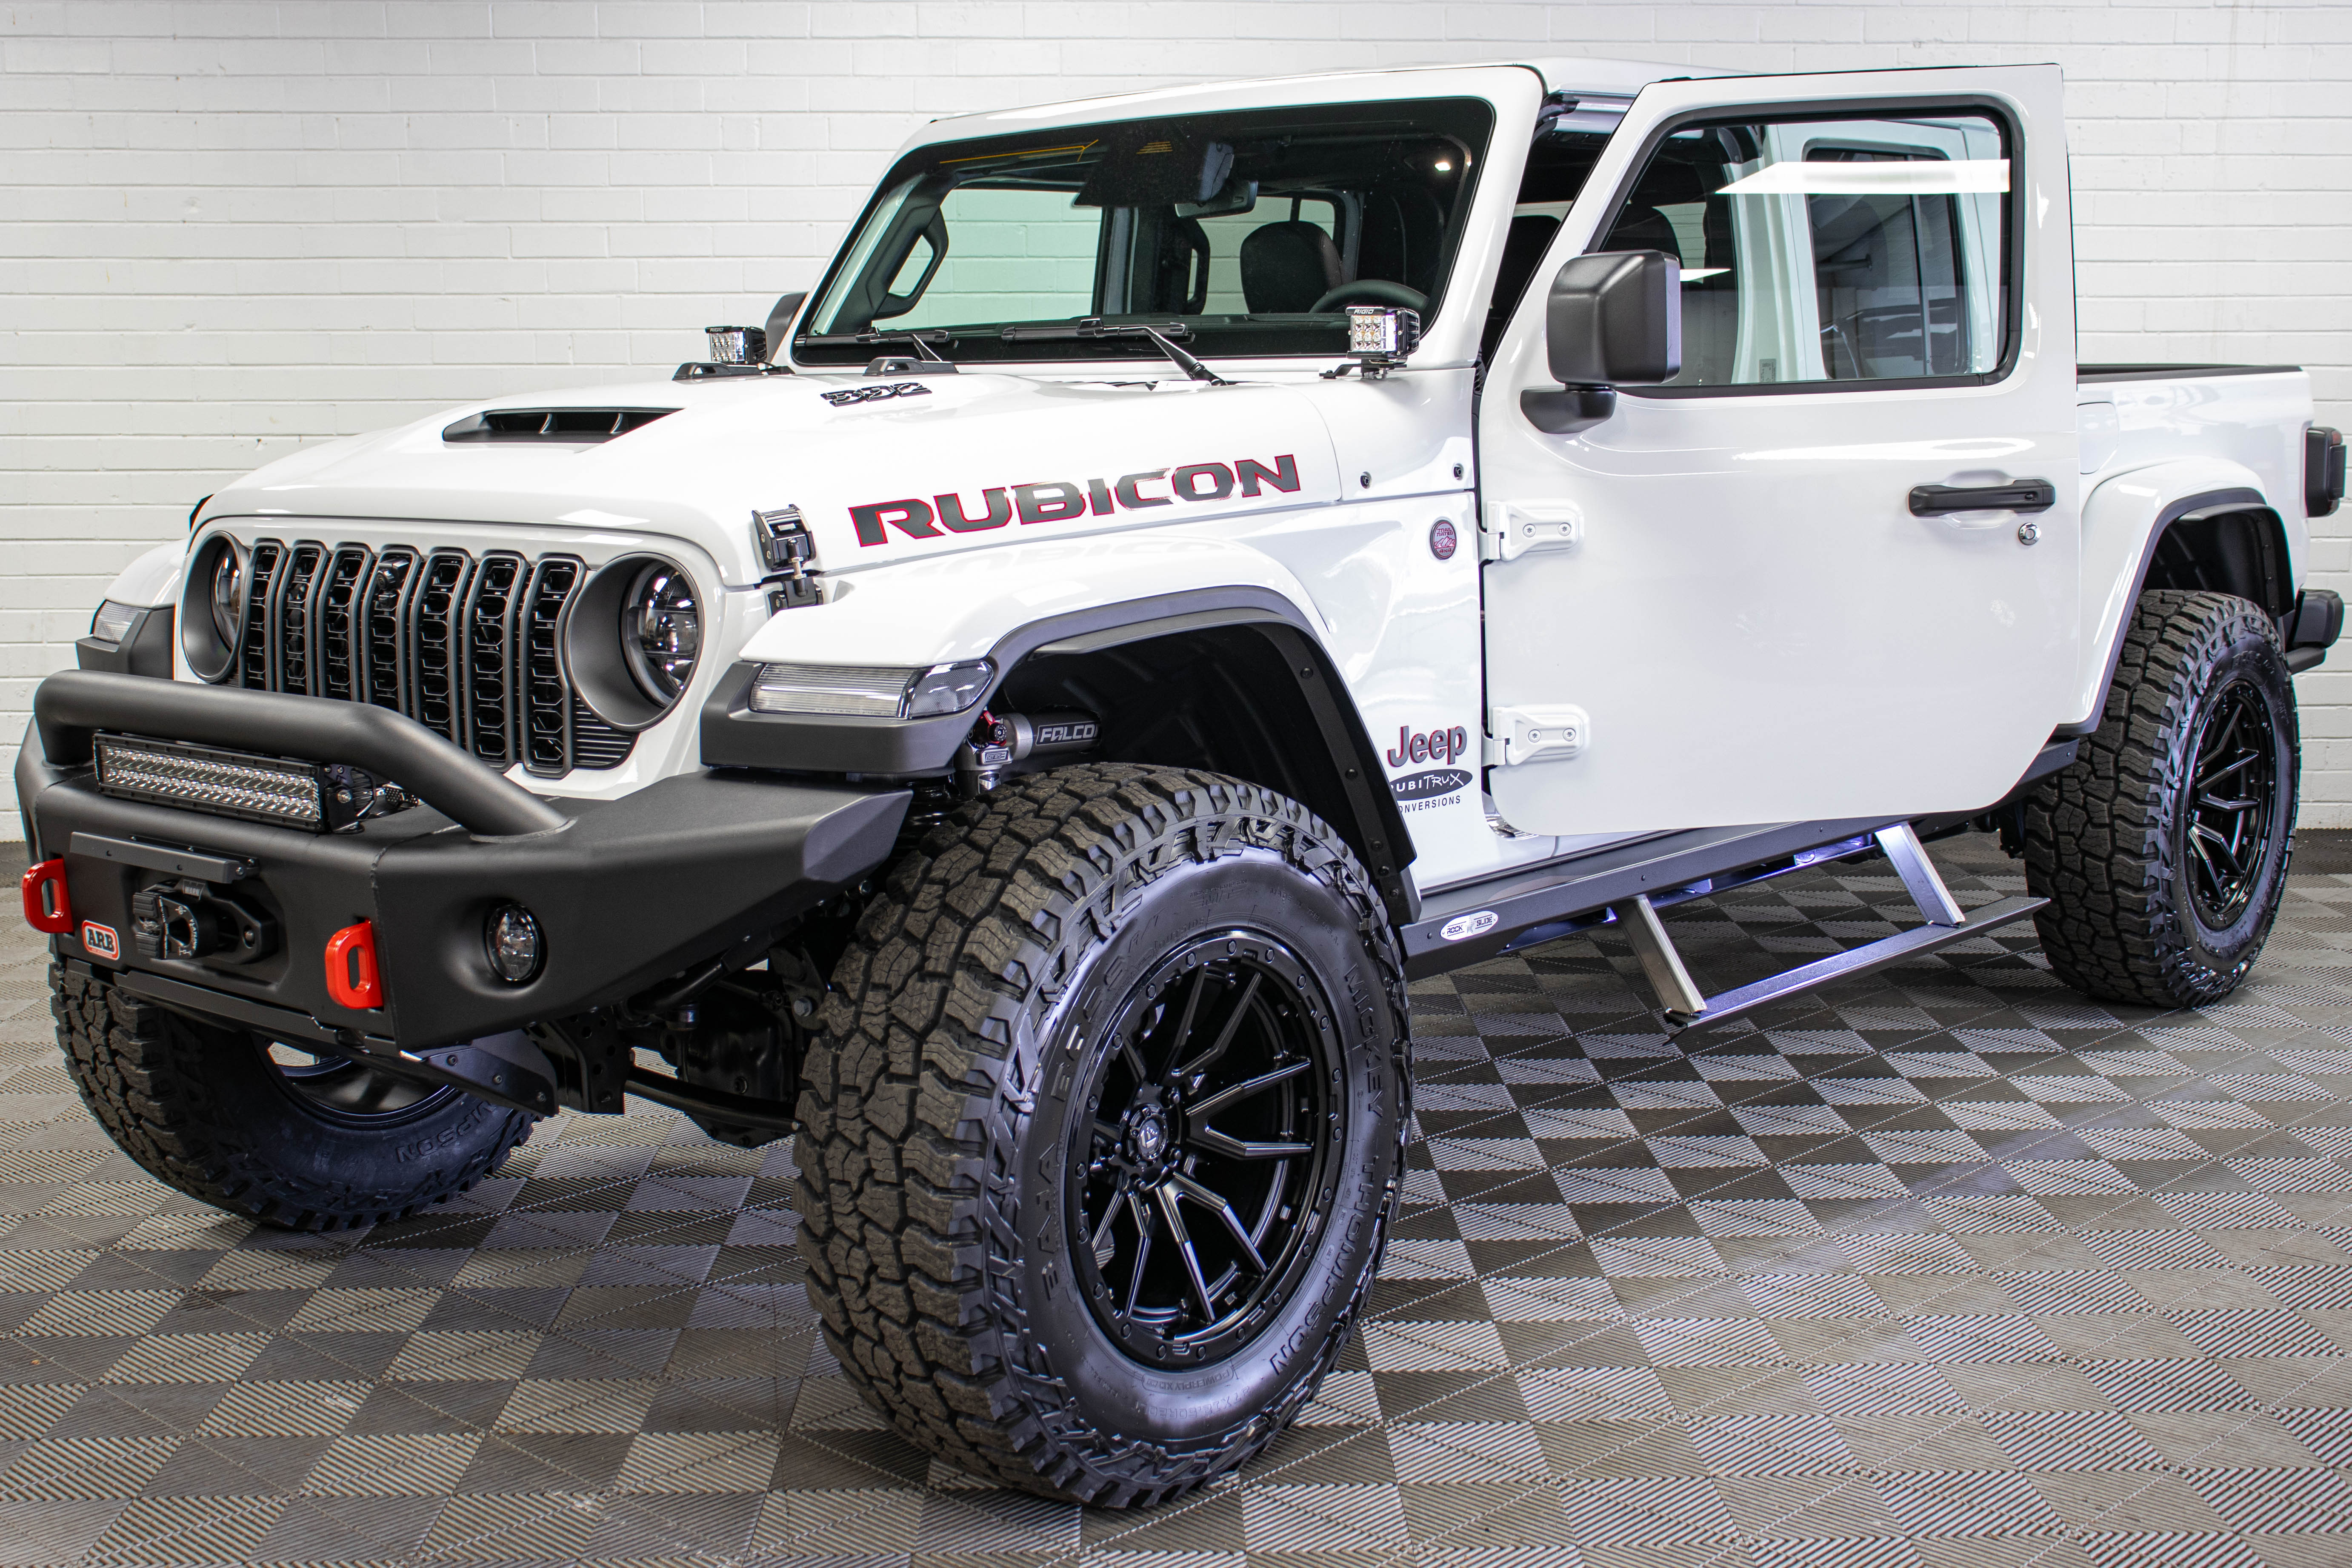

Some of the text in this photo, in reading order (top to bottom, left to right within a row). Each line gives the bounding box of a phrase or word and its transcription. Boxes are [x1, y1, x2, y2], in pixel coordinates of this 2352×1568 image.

[820, 382, 932, 407] 392
[848, 454, 1301, 547] RUBICON
[1388, 725, 1467, 767] Jeep
[1391, 773, 1464, 792] UBITRUX
[1399, 795, 1460, 814] ONVERSIONS
[88, 928, 115, 952] ARB
[1447, 917, 1492, 934] ROCK SLIDE
[396, 1100, 497, 1162] MPSON
[1269, 963, 1383, 1375] MICKEY THOMPSON
[1036, 1143, 1059, 1301] BAJA
